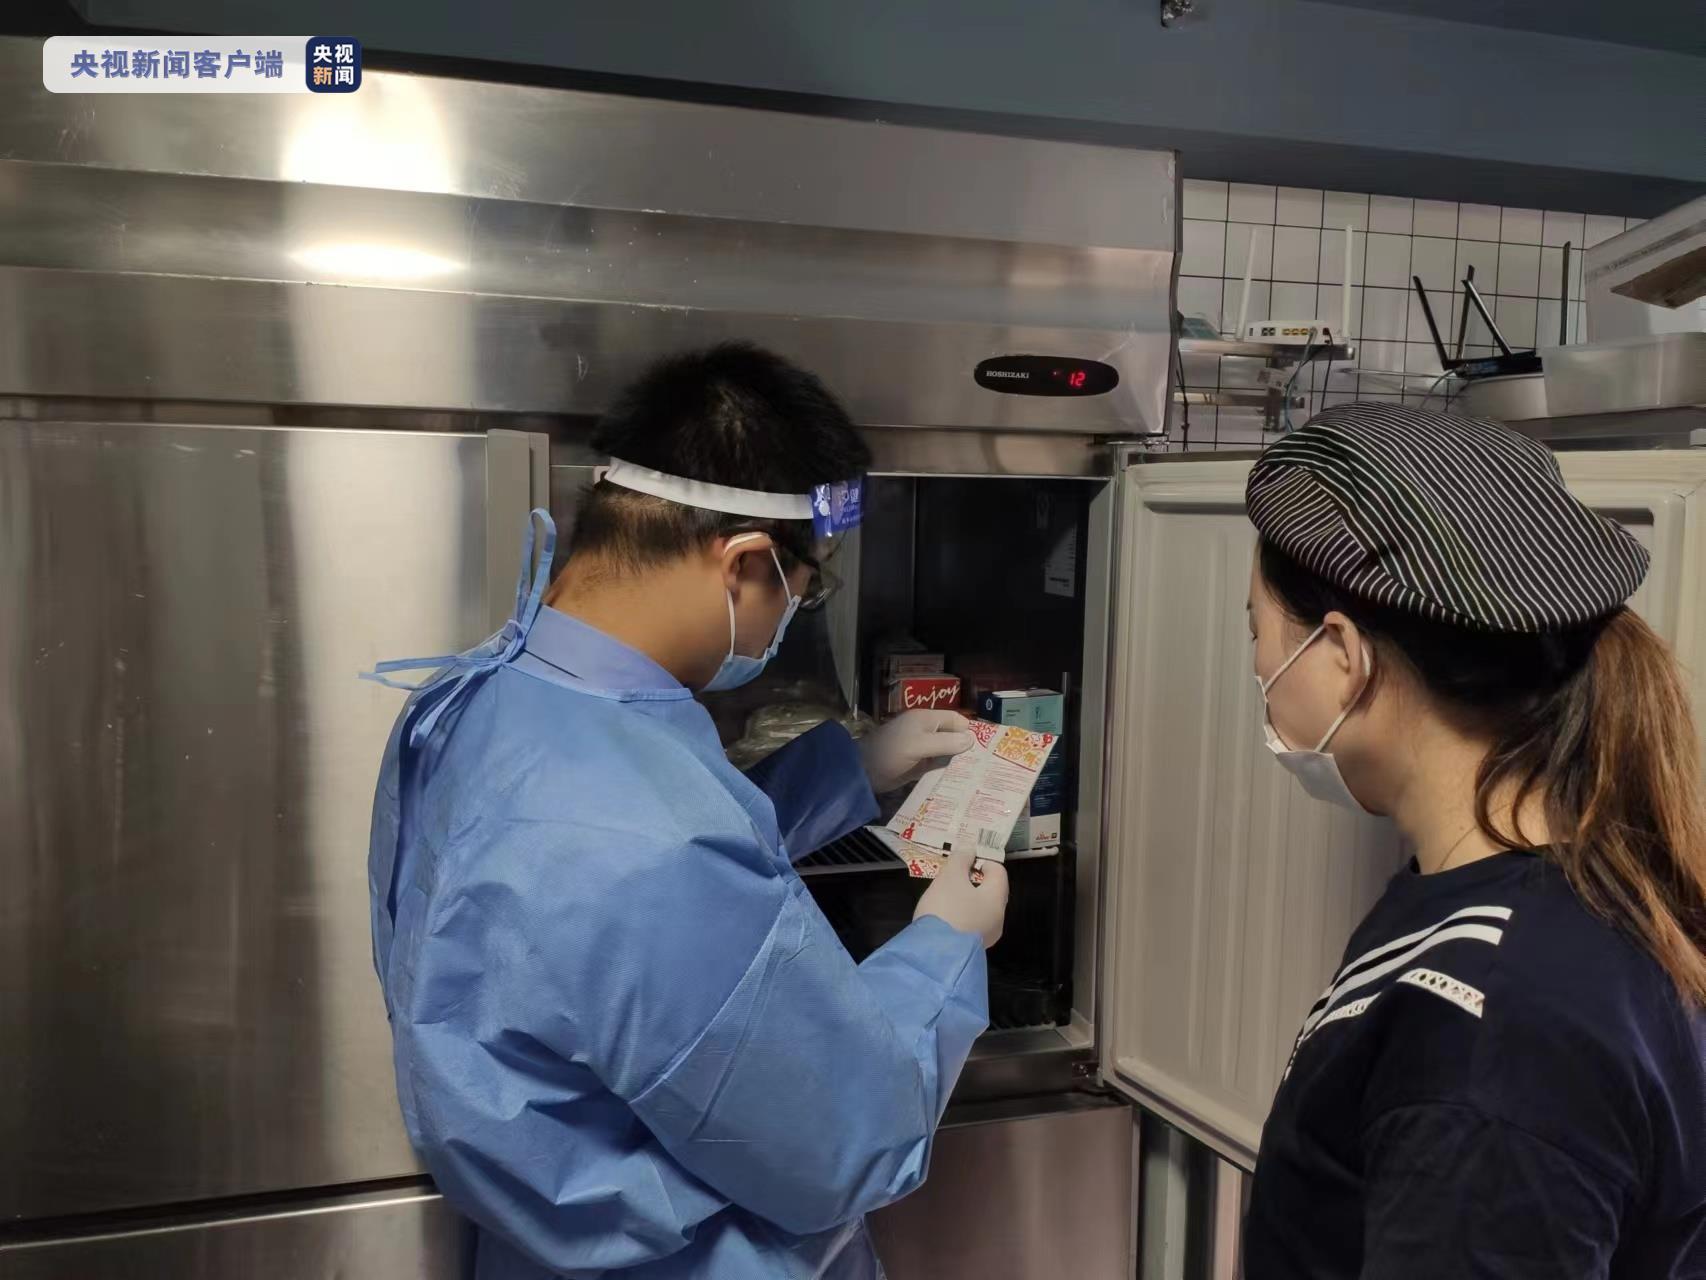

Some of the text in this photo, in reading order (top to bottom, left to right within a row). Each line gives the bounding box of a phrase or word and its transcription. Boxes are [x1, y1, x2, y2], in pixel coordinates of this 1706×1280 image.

[986, 371, 1029, 379] HOSHIZAKI
[1070, 371, 1086, 387] 12
[904, 685, 960, 709] Enjoy
